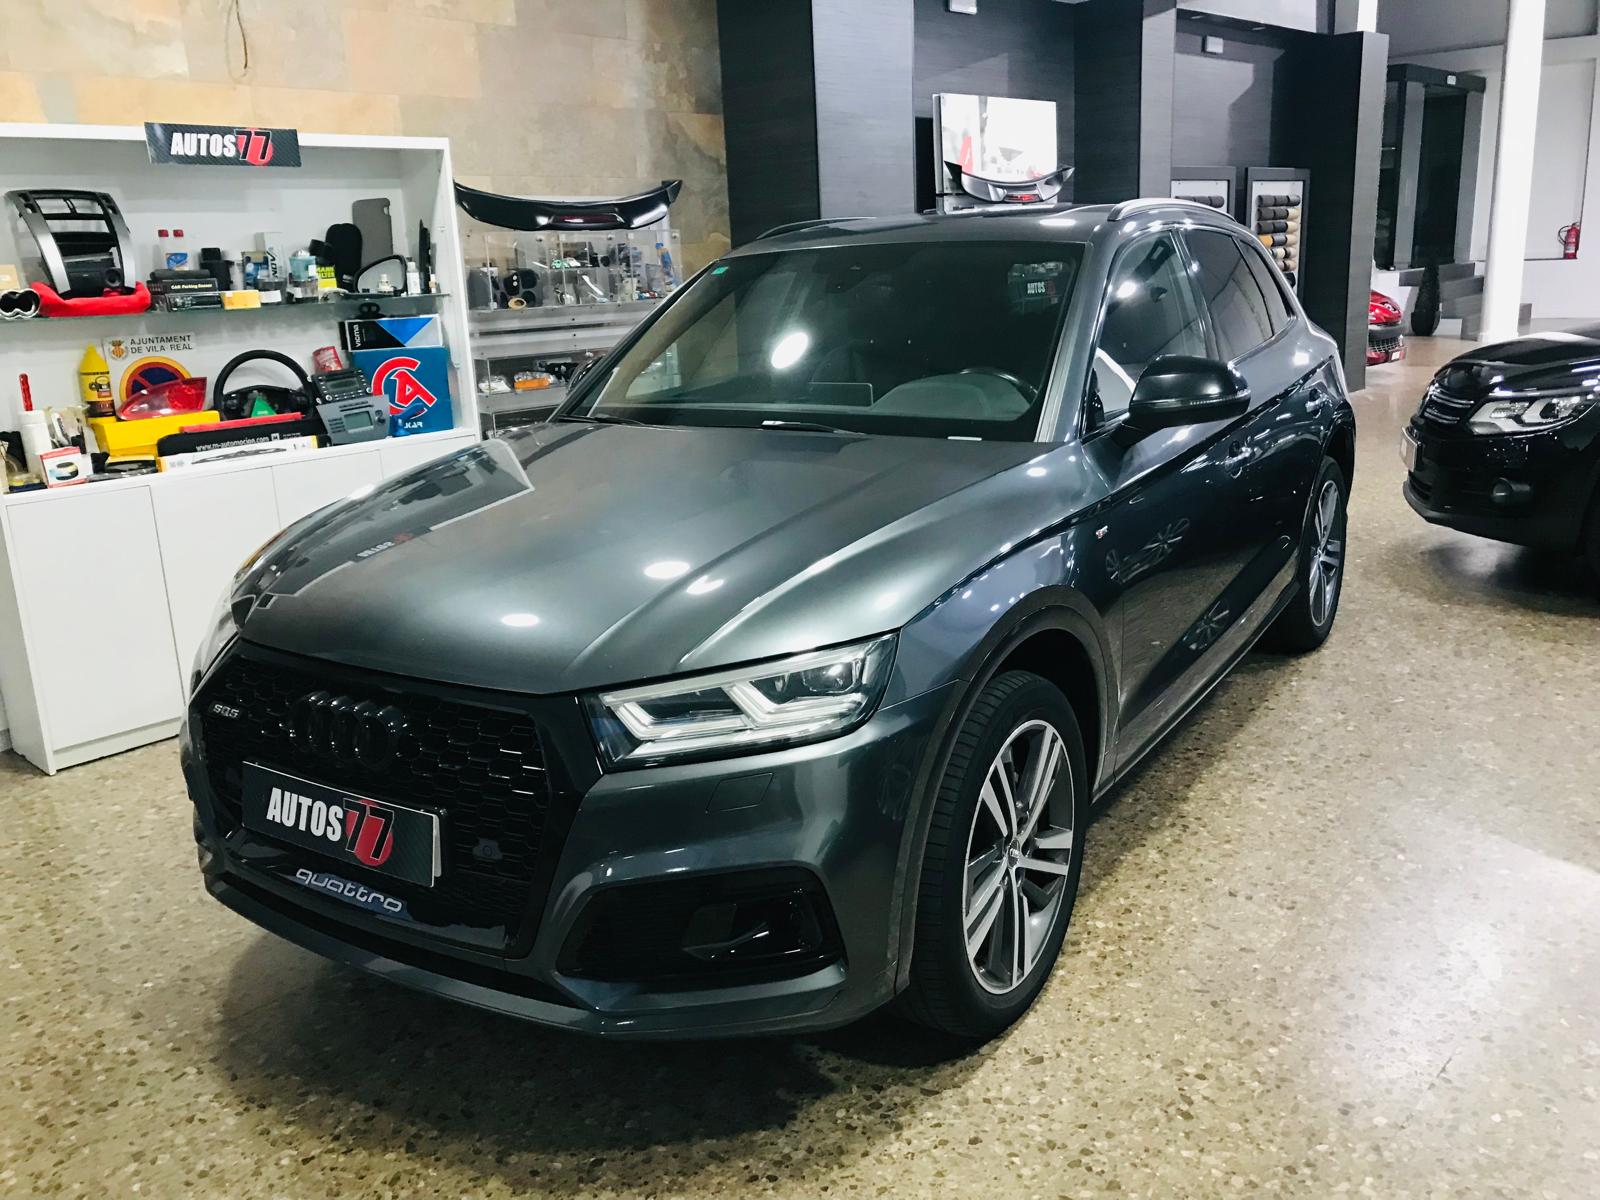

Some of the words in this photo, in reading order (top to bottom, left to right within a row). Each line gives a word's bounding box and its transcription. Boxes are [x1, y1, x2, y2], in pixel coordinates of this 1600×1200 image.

[130, 334, 191, 346] AJUNTAMENT
[130, 346, 143, 354] DE
[146, 344, 166, 353] VILA
[170, 343, 193, 351] REAL
[296, 868, 402, 913] quattro
